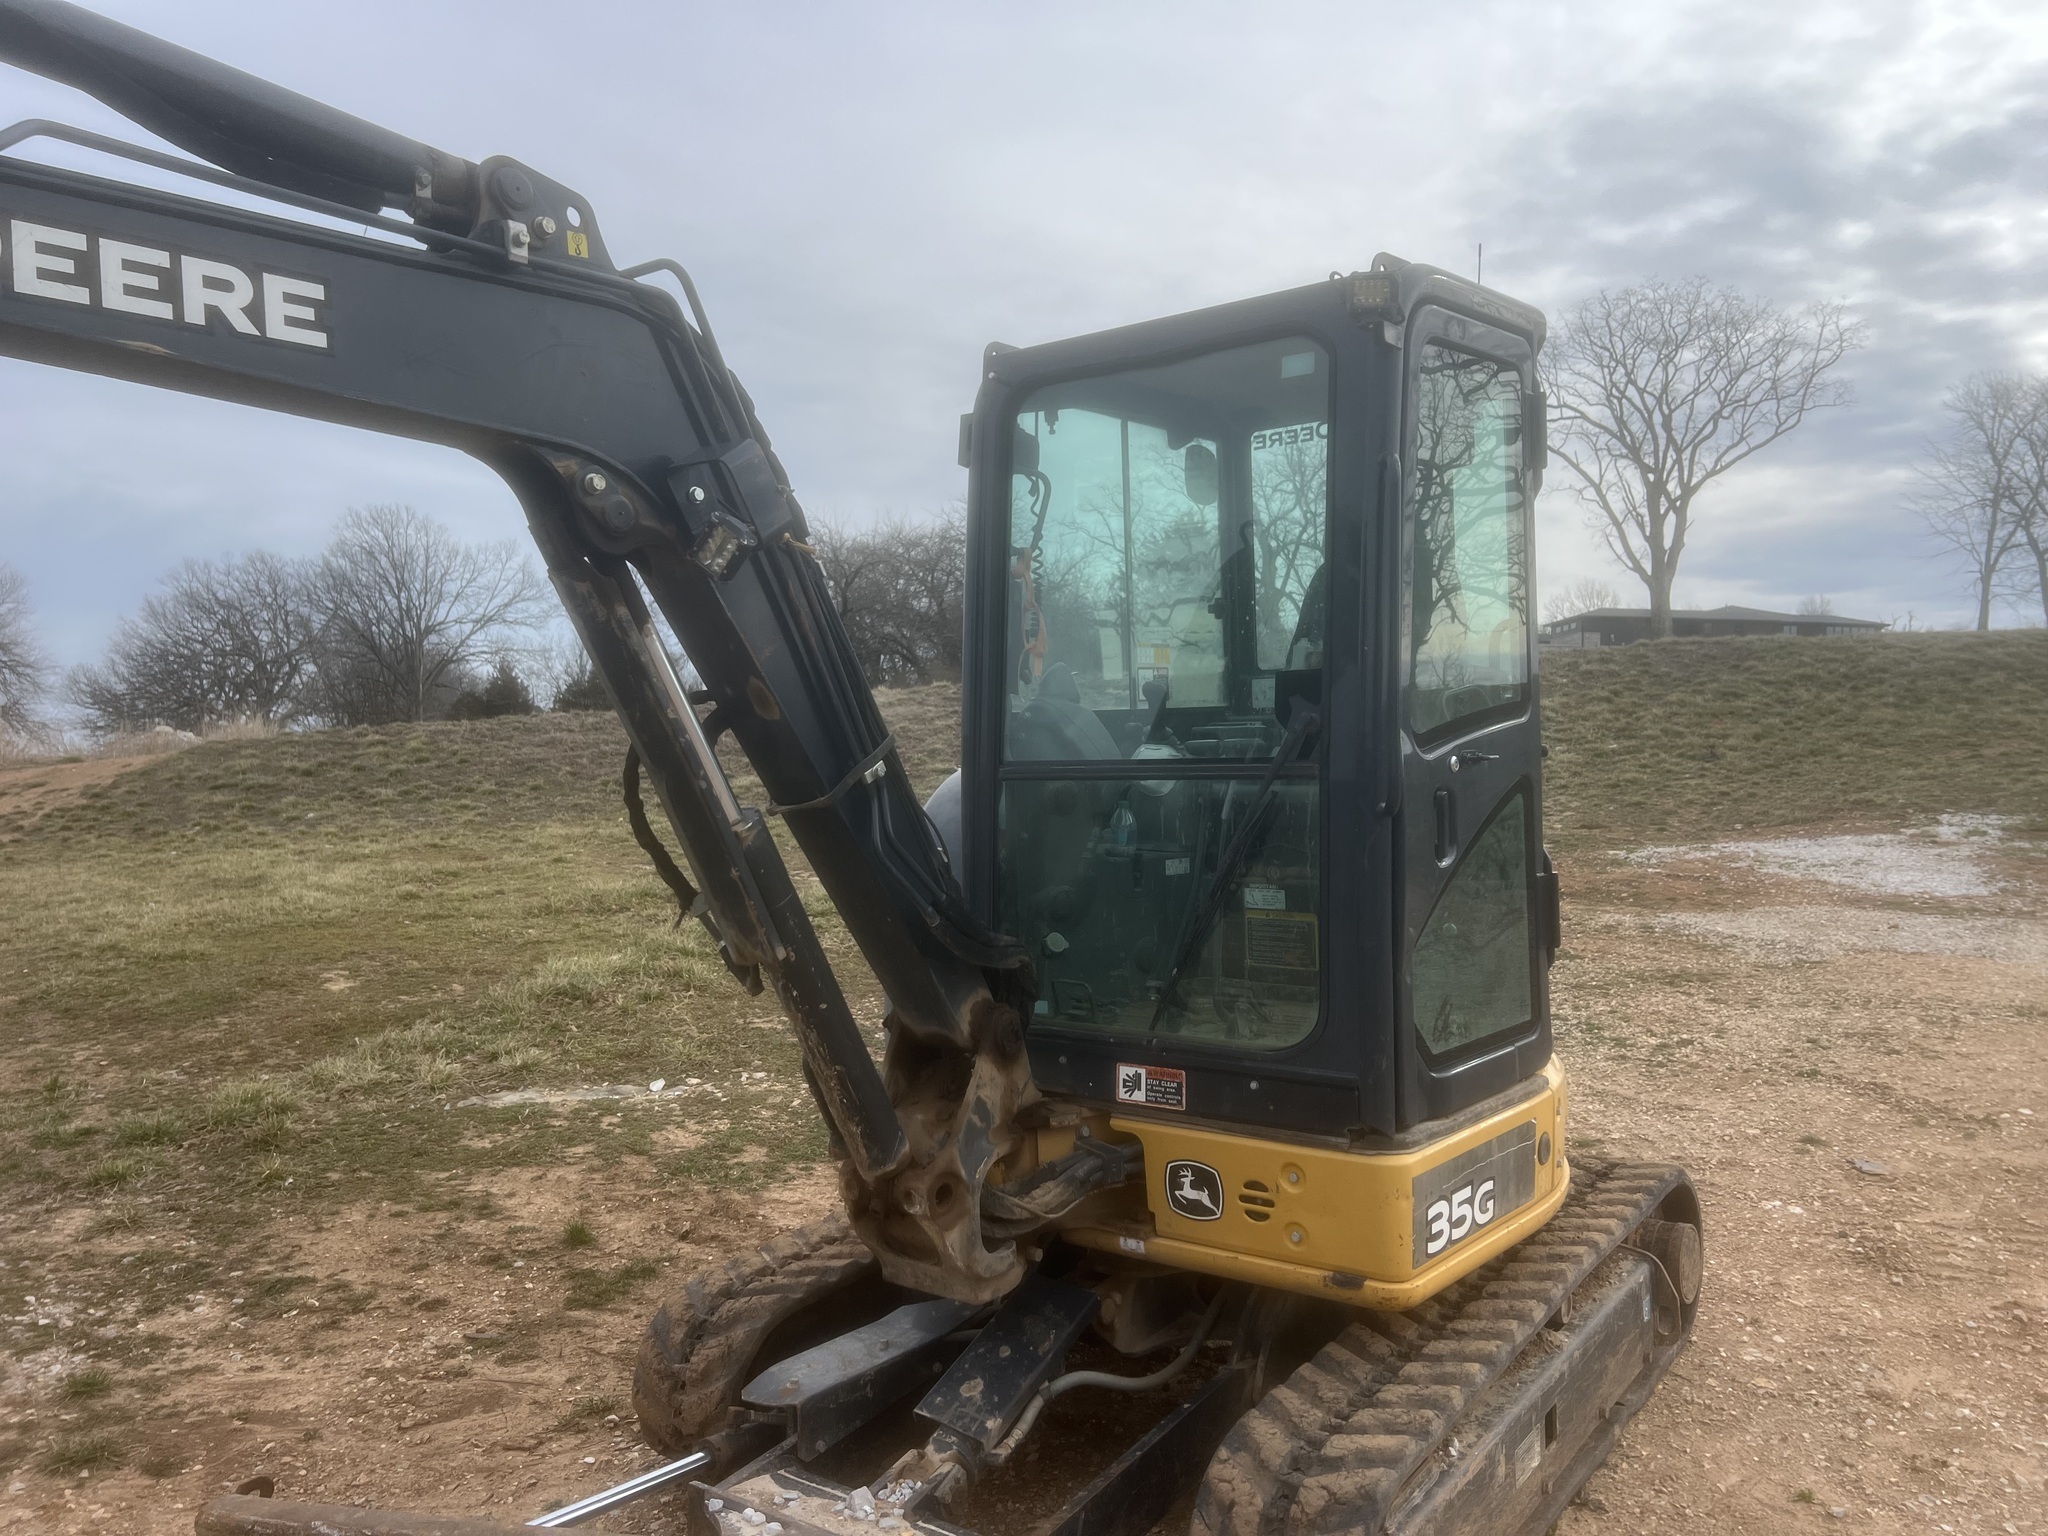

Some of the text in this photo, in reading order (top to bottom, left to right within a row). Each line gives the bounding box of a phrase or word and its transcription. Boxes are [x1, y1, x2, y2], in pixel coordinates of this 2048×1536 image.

[0, 219, 328, 348] EERE
[1151, 1069, 1183, 1080] WARNING
[1427, 1180, 1494, 1254] 35G
